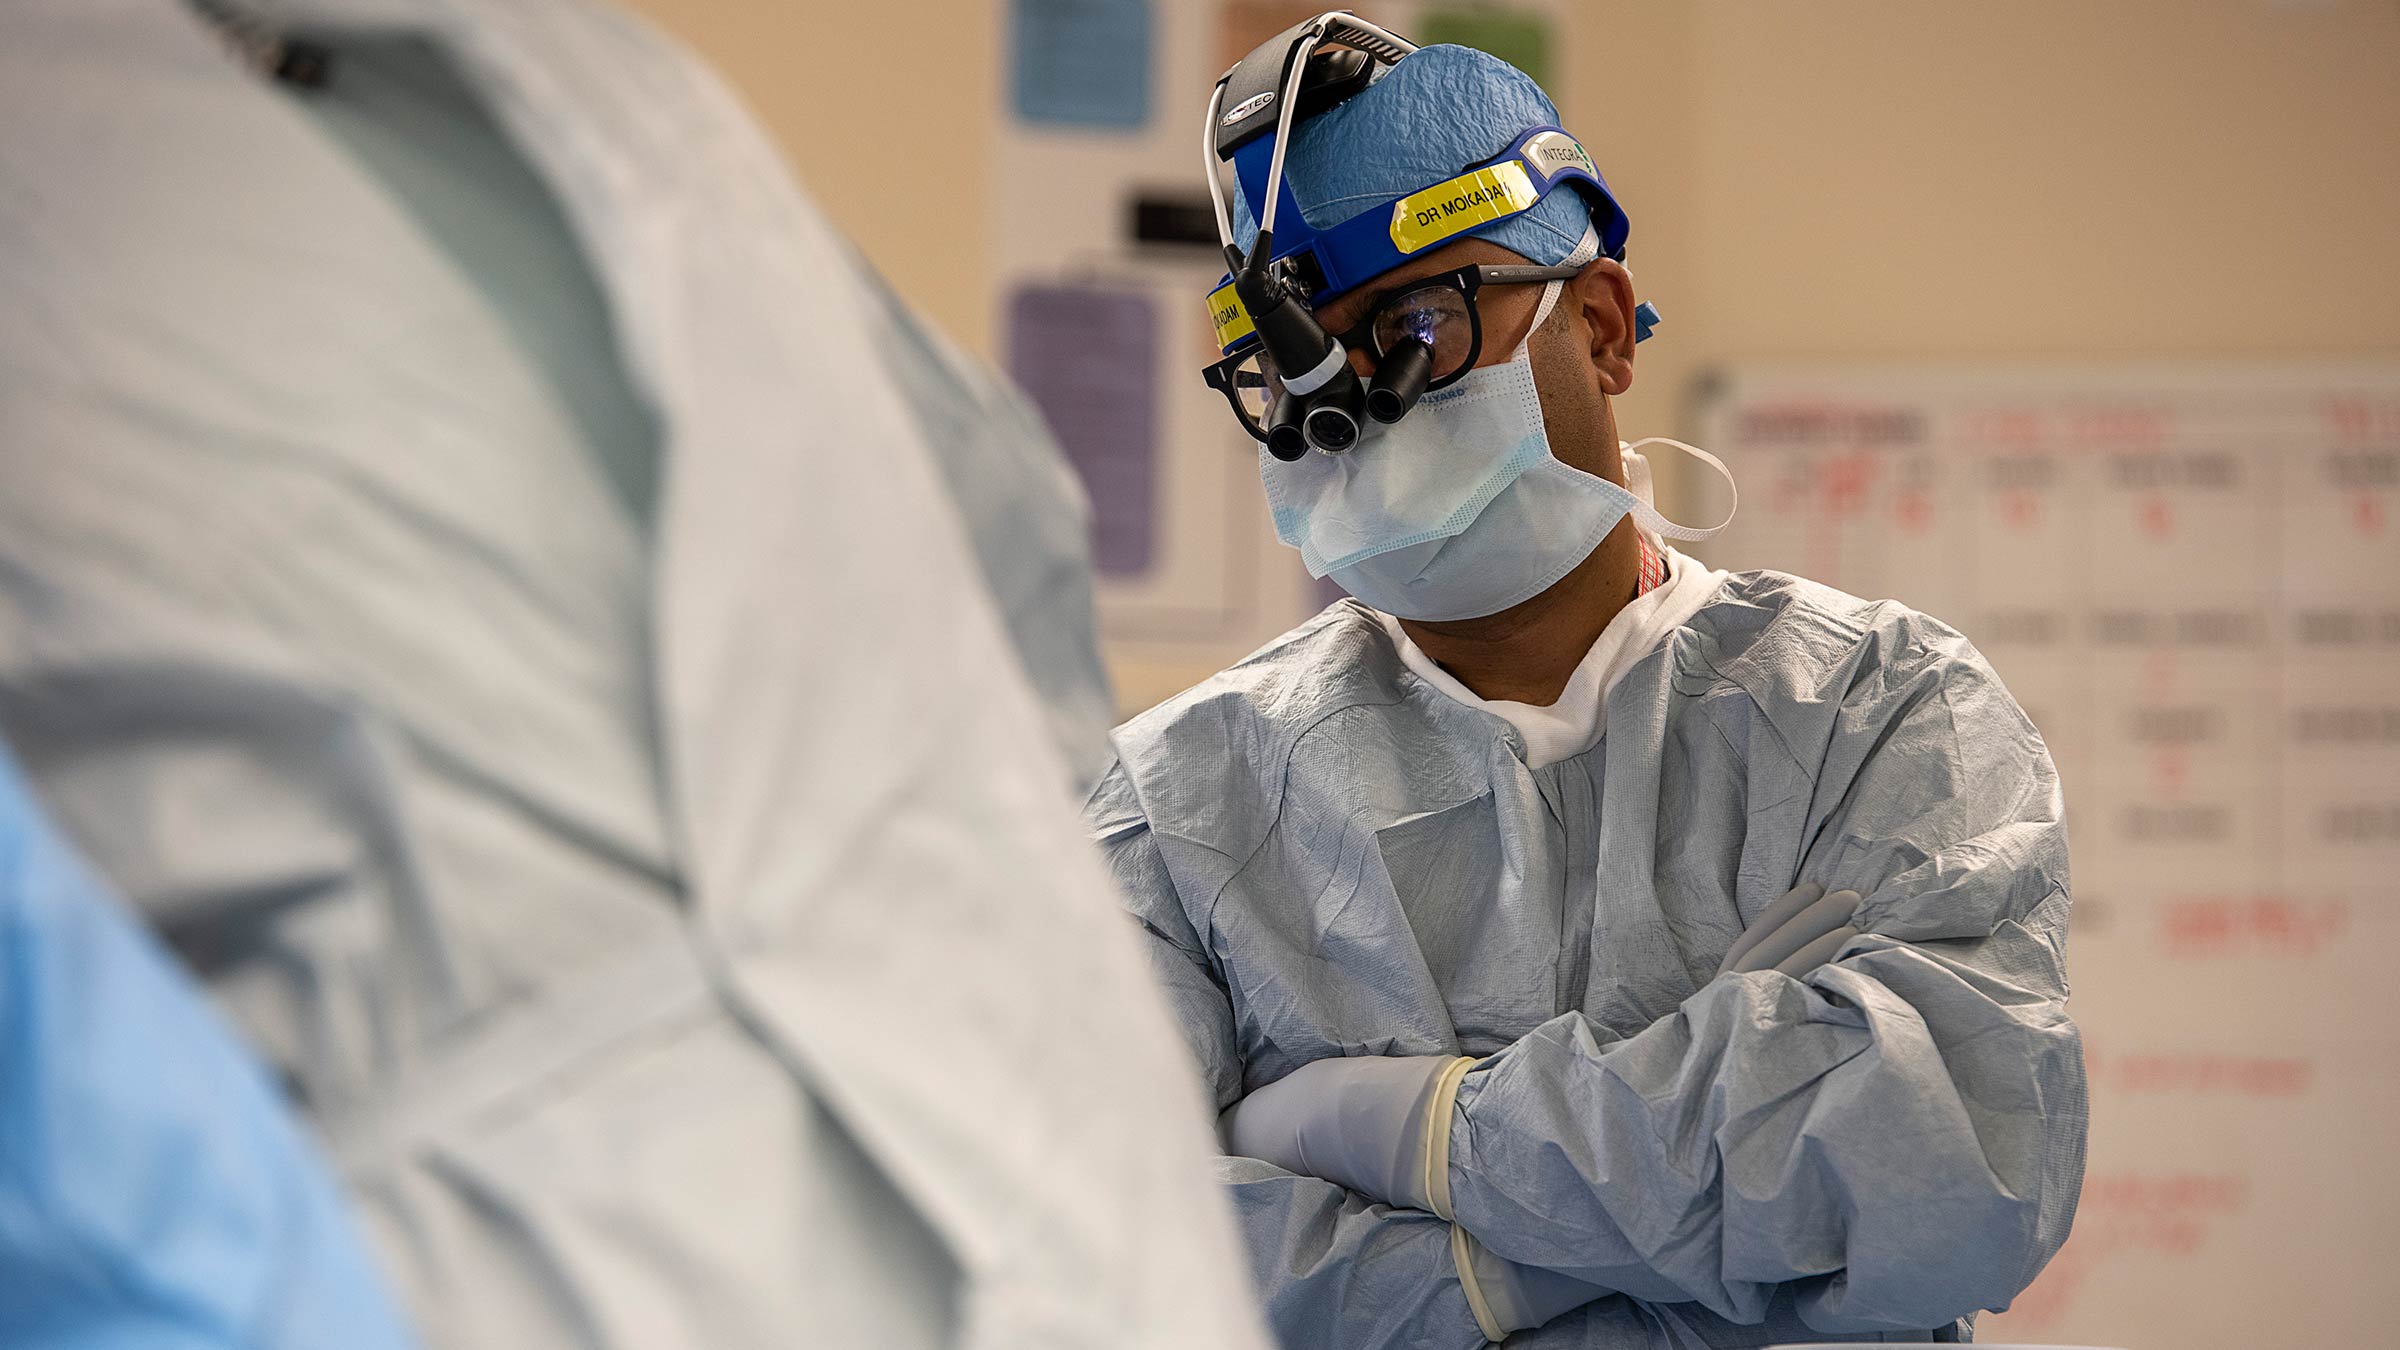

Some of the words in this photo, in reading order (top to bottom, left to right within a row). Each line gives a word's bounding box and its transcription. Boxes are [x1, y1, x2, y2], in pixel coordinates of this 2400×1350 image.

[1222, 94, 1272, 125] LTEC
[1543, 148, 1584, 162] INTEGRA
[1416, 207, 1442, 227] DR
[1213, 304, 1240, 330] OKADAM
[1418, 387, 1466, 403] ALYARD
